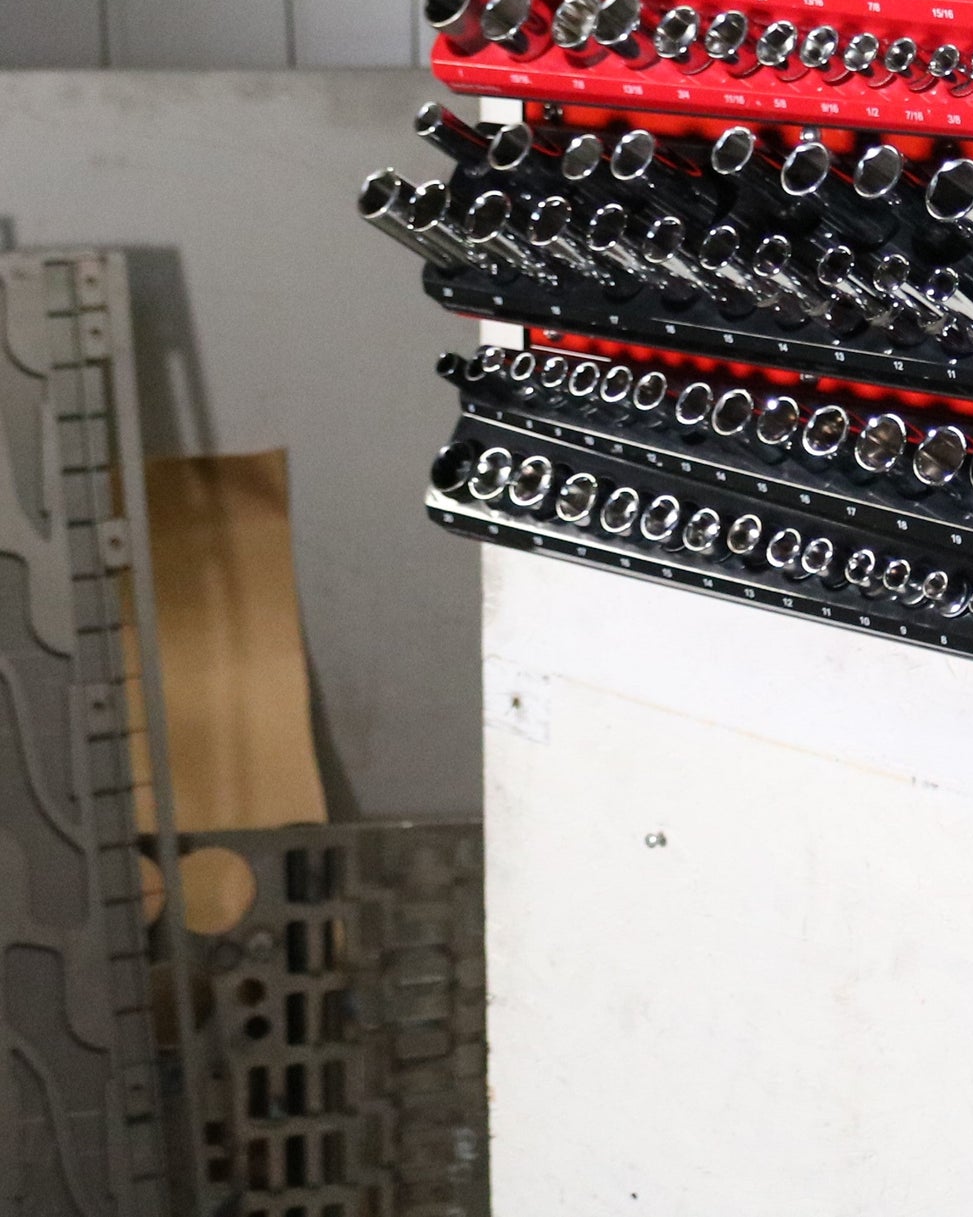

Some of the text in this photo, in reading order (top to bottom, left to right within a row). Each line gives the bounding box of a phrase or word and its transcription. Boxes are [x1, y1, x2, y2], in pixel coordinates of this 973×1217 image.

[868, 2, 880, 12] 7/8
[932, 8, 954, 19] 15/16
[821, 103, 839, 113] 9/16
[866, 107, 879, 117] 1/2
[905, 110, 923, 121] 7/16
[947, 114, 961, 124] 3/8
[778, 343, 788, 352] 14
[835, 352, 845, 361] 13
[893, 361, 903, 370] 12
[947, 370, 956, 378] 11
[847, 507, 856, 516] 17
[897, 520, 907, 530] 18
[951, 534, 961, 544] 19
[744, 589, 755, 598] 13
[783, 598, 793, 607] 12
[822, 607, 831, 616] 11
[860, 616, 870, 626] 10
[900, 626, 907, 635] 9
[941, 636, 947, 644] 8
